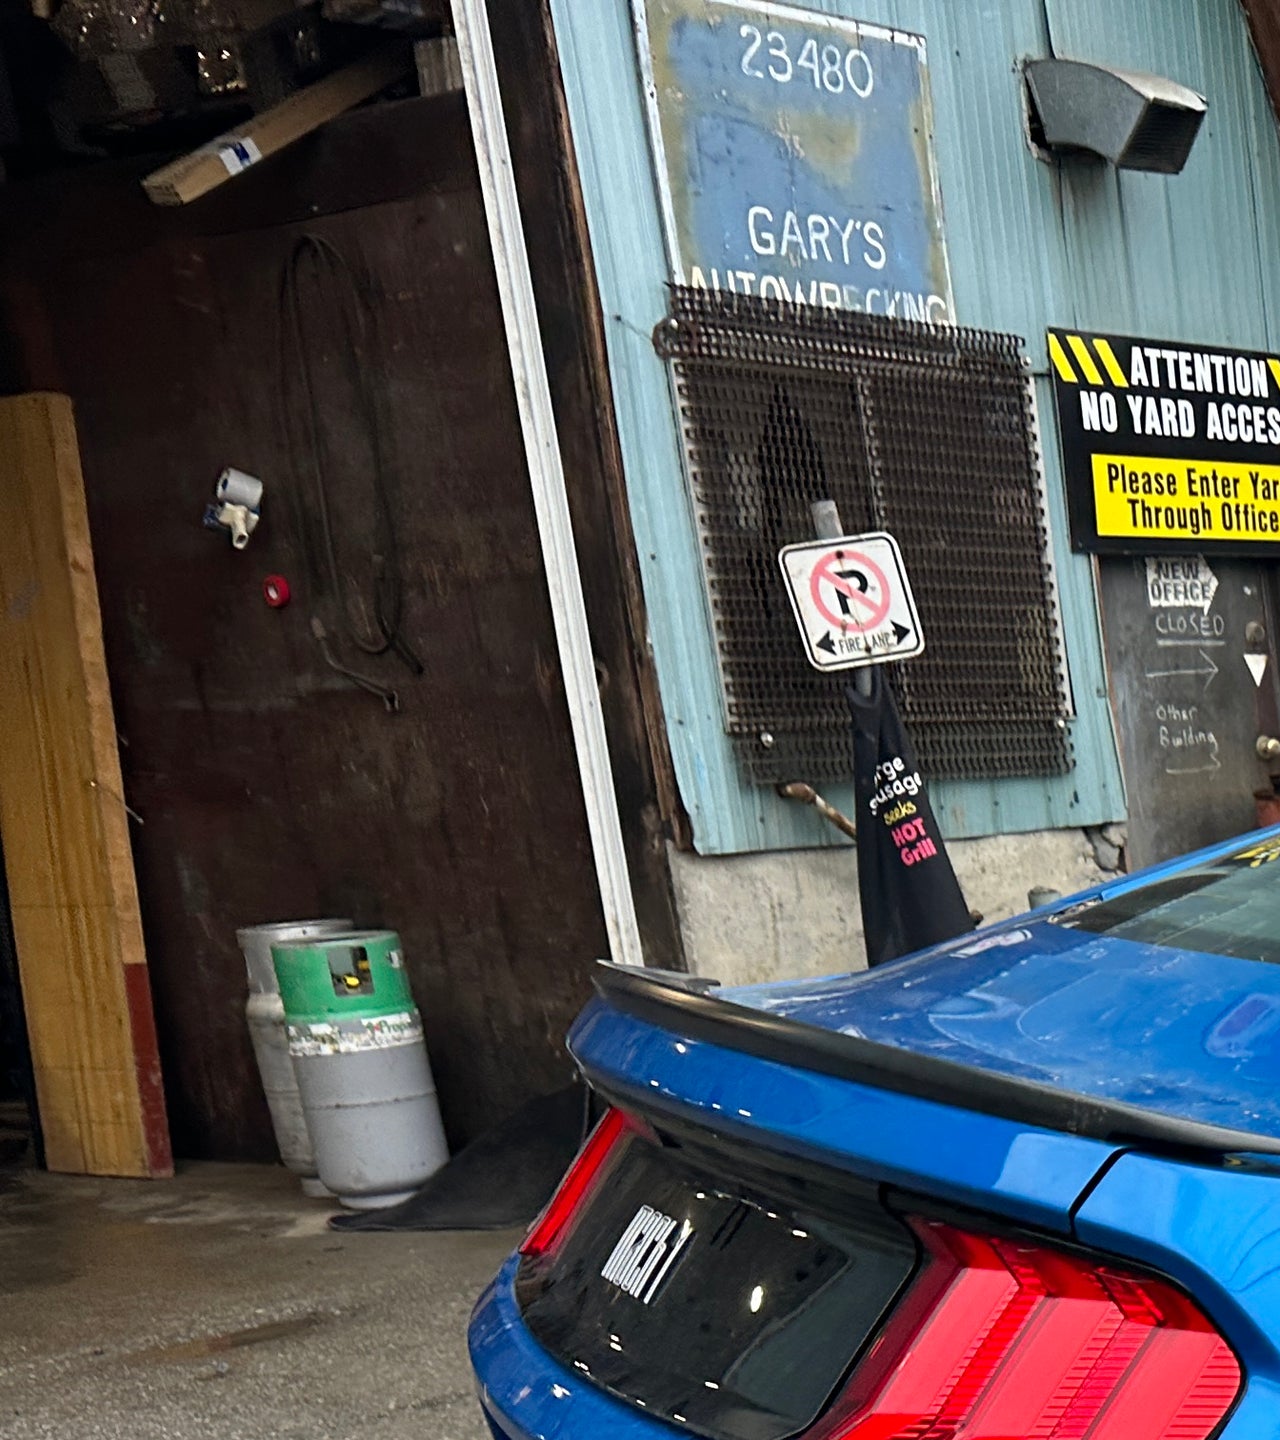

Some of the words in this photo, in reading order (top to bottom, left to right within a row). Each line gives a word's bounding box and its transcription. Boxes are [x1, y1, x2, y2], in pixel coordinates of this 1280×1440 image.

[740, 25, 874, 98] 23480
[748, 206, 886, 270] GARY'S
[1130, 346, 1269, 398] ATTENTION
[1080, 390, 1118, 433] NO
[1129, 394, 1196, 438] YARD
[1107, 463, 1177, 497] Please
[1187, 468, 1240, 499] Enter
[1127, 499, 1212, 535] Through
[1222, 503, 1279, 533] Office
[1155, 560, 1199, 580] NEW
[1151, 580, 1211, 601] OFFICE
[1155, 614, 1225, 637] CLOSED
[838, 637, 862, 654] FIRE
[1156, 704, 1198, 721] Other
[1159, 728, 1218, 751] Building
[869, 771, 922, 816] ausag
[883, 800, 917, 826] seeks
[891, 817, 926, 848] HOT
[900, 837, 938, 866] Grill
